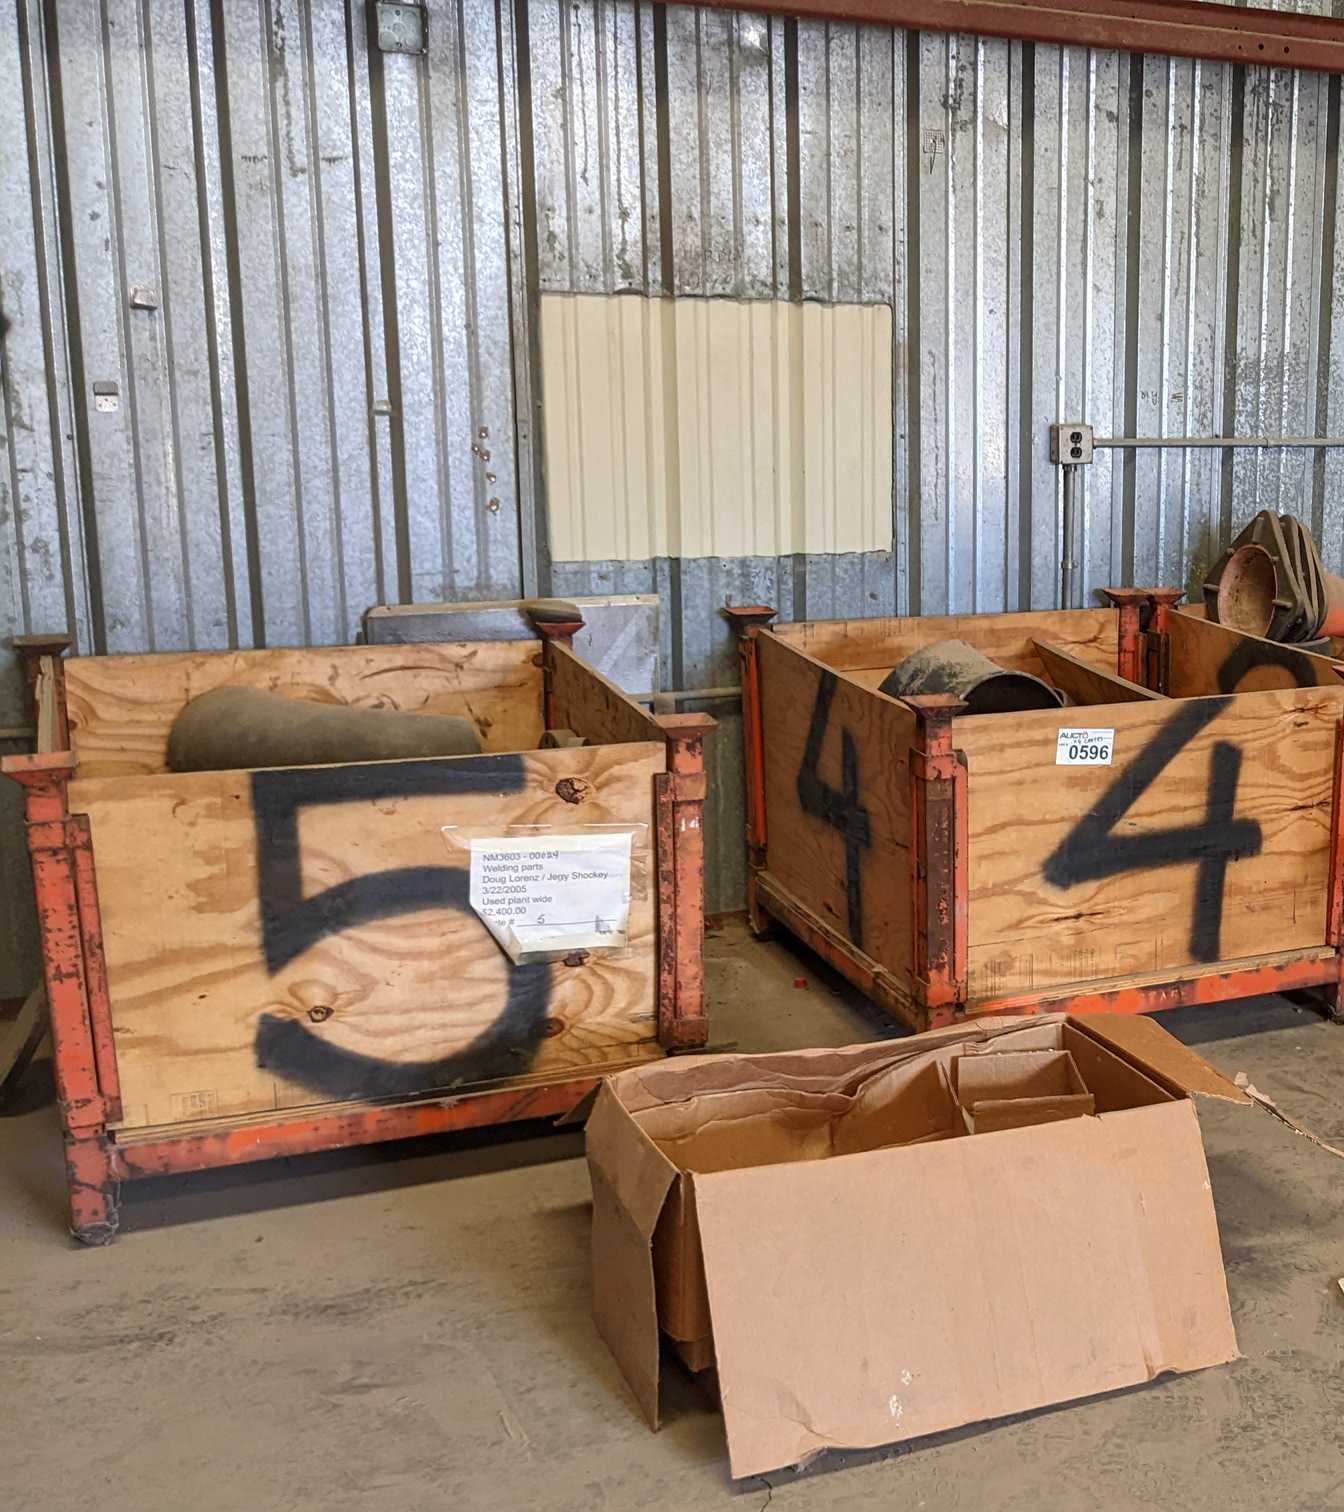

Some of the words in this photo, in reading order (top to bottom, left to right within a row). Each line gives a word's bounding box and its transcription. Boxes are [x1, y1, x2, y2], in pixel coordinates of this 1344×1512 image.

[1069, 744, 1109, 760] 0596
[796, 669, 871, 952] 4
[1041, 694, 1263, 964] 4
[482, 864, 519, 873] Welding
[521, 863, 544, 872] parts
[482, 875, 507, 884] Doug
[509, 873, 540, 883] Lorenz
[571, 871, 608, 880] Shockey
[482, 885, 527, 894] 3/22/2005
[482, 897, 506, 906] Used
[507, 896, 530, 905] plant
[532, 895, 553, 903] wide
[250, 753, 553, 1104] 5
